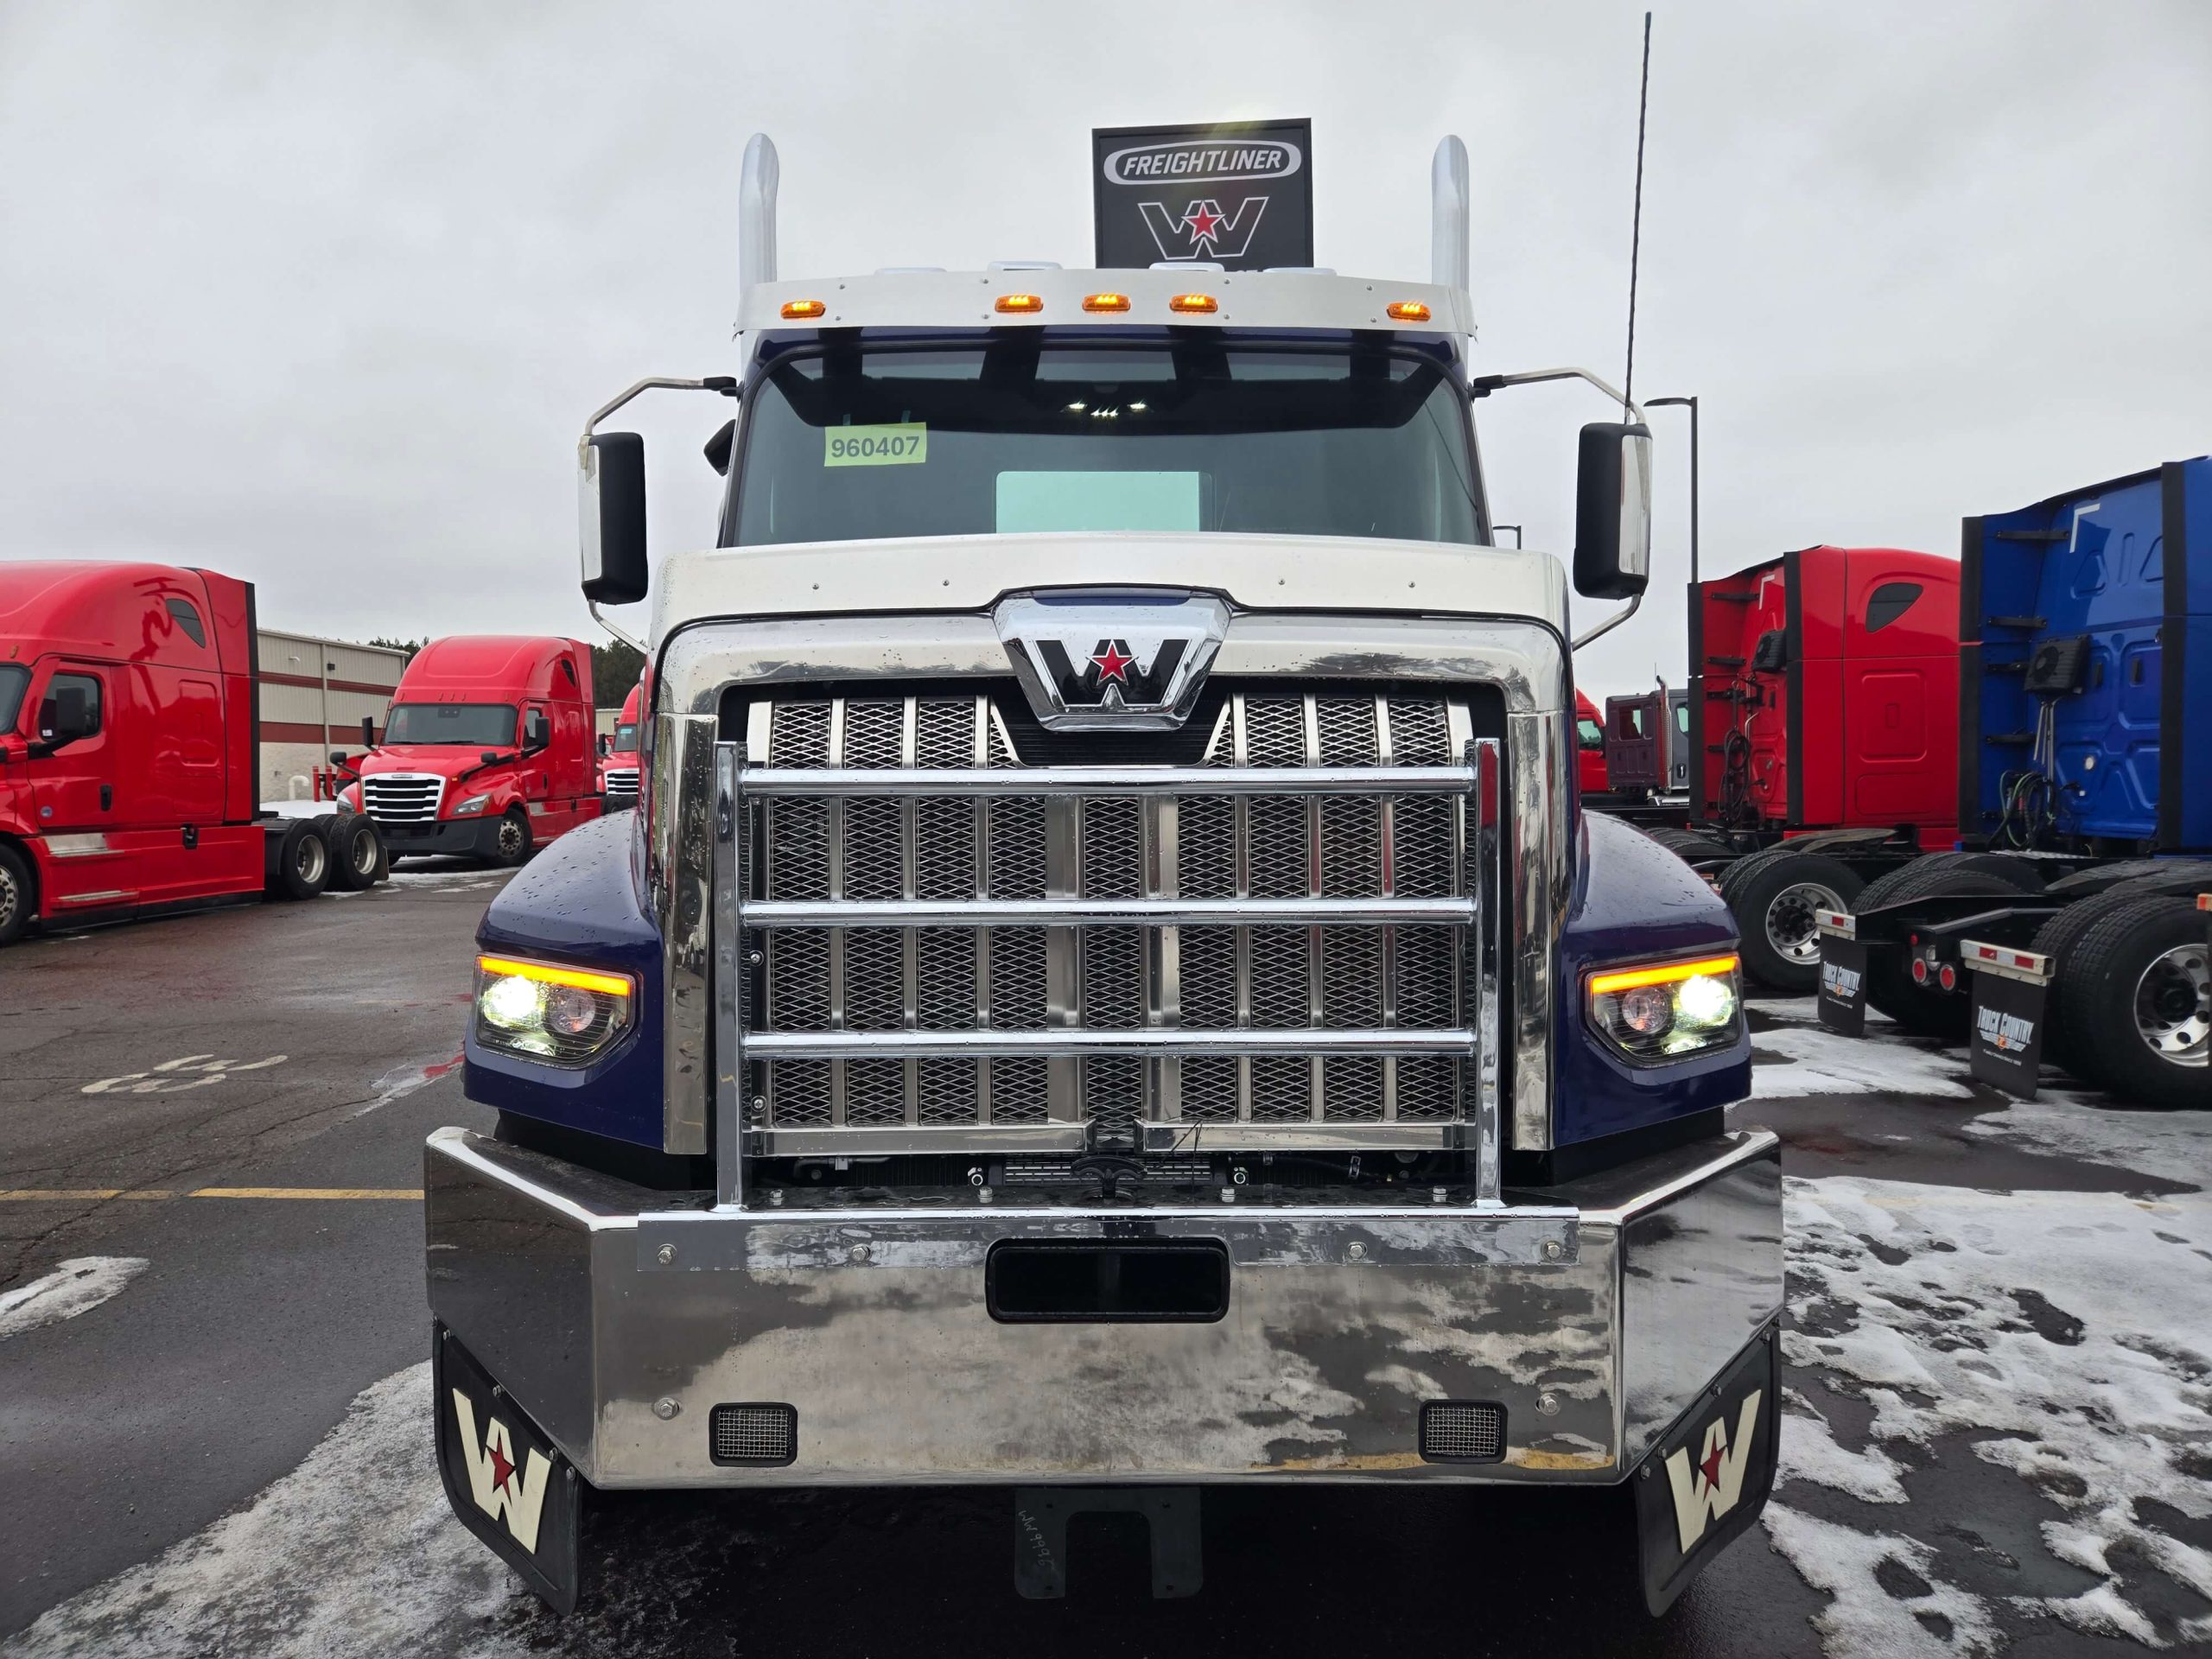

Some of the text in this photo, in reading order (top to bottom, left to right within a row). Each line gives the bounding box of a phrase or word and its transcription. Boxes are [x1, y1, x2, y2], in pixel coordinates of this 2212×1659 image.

[1123, 149, 1281, 175] FREIGHTLINER
[831, 435, 920, 458] 960407
[1977, 1006, 2001, 1034] TRUCK
